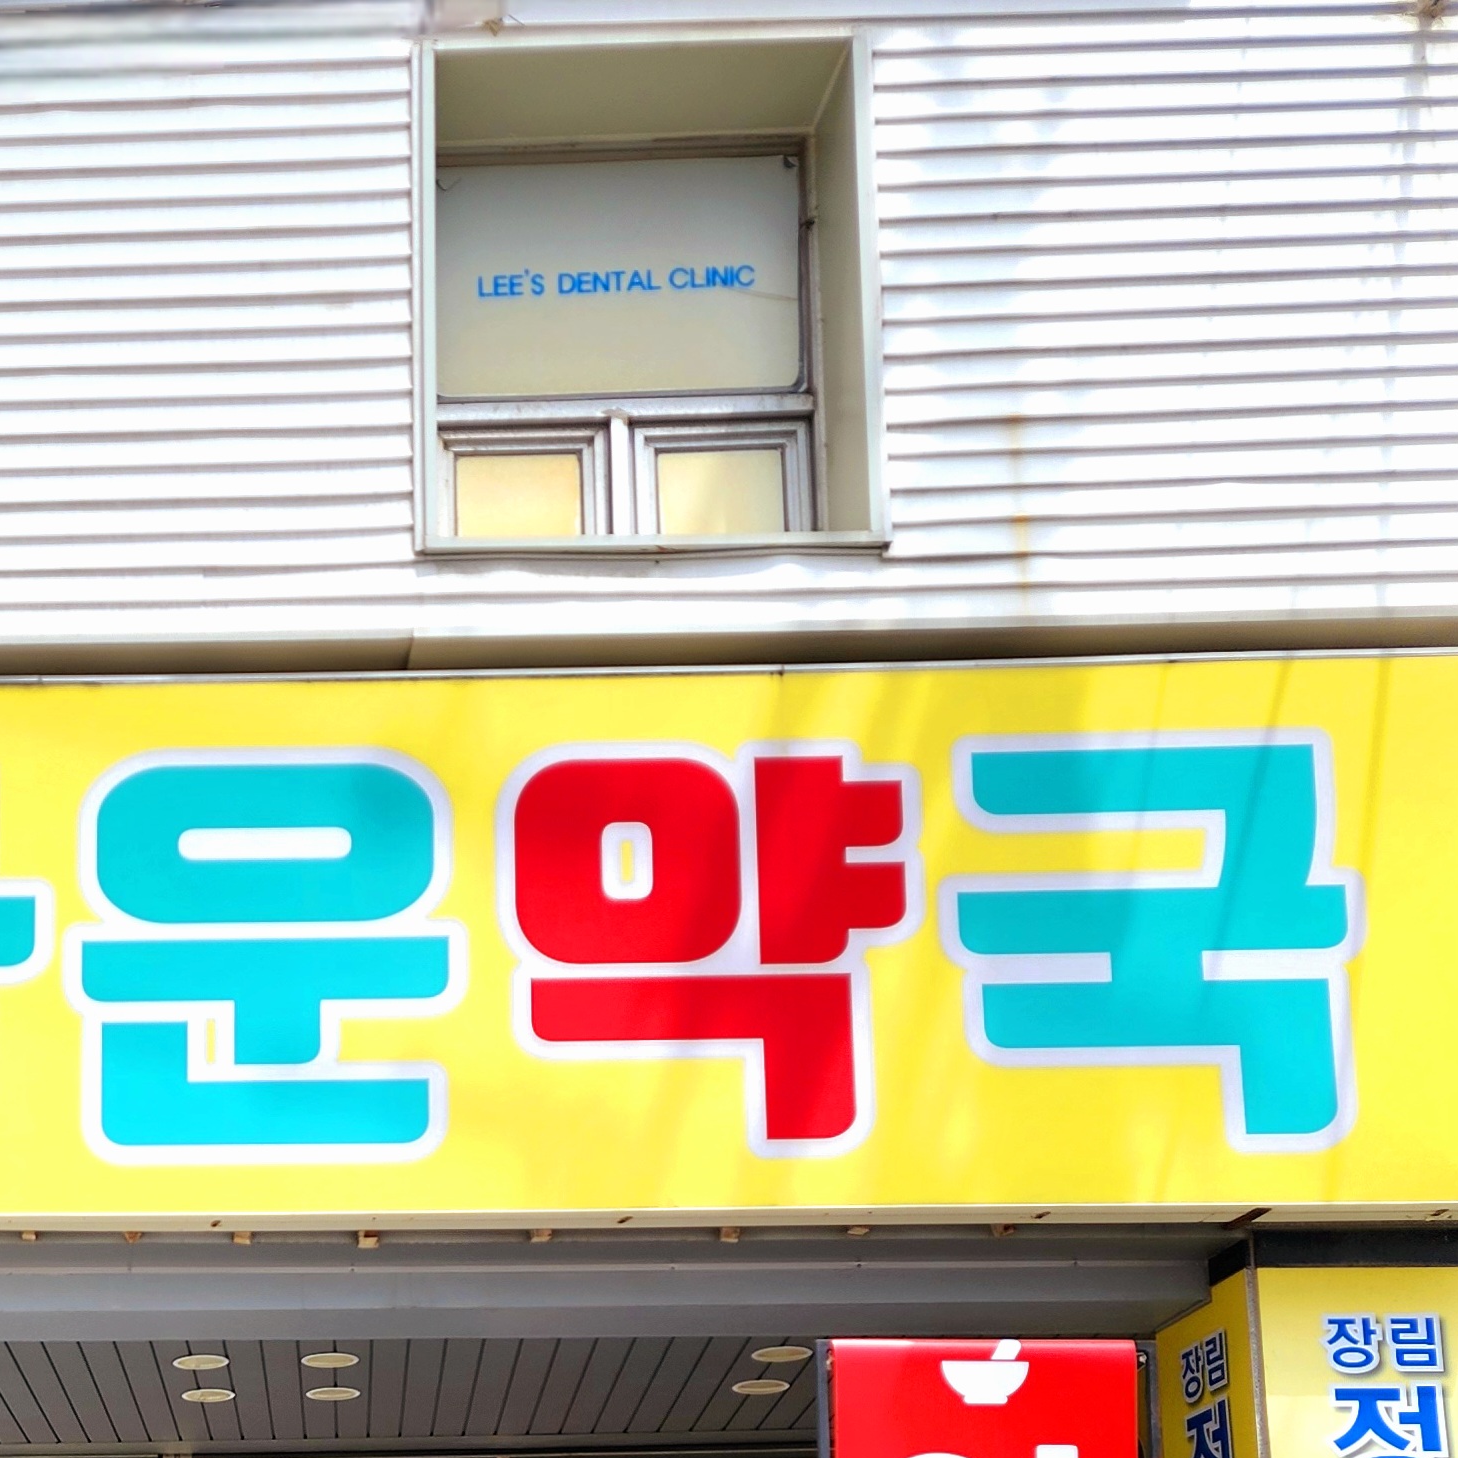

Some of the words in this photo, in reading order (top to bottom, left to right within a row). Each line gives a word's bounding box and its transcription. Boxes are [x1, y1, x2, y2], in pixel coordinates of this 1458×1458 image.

[478, 268, 545, 298] LEE'S
[558, 269, 661, 294] DENTAL
[669, 264, 755, 289] CLINIC
[1179, 1328, 1227, 1402] 장림
[1320, 1314, 1443, 1376] 장림
